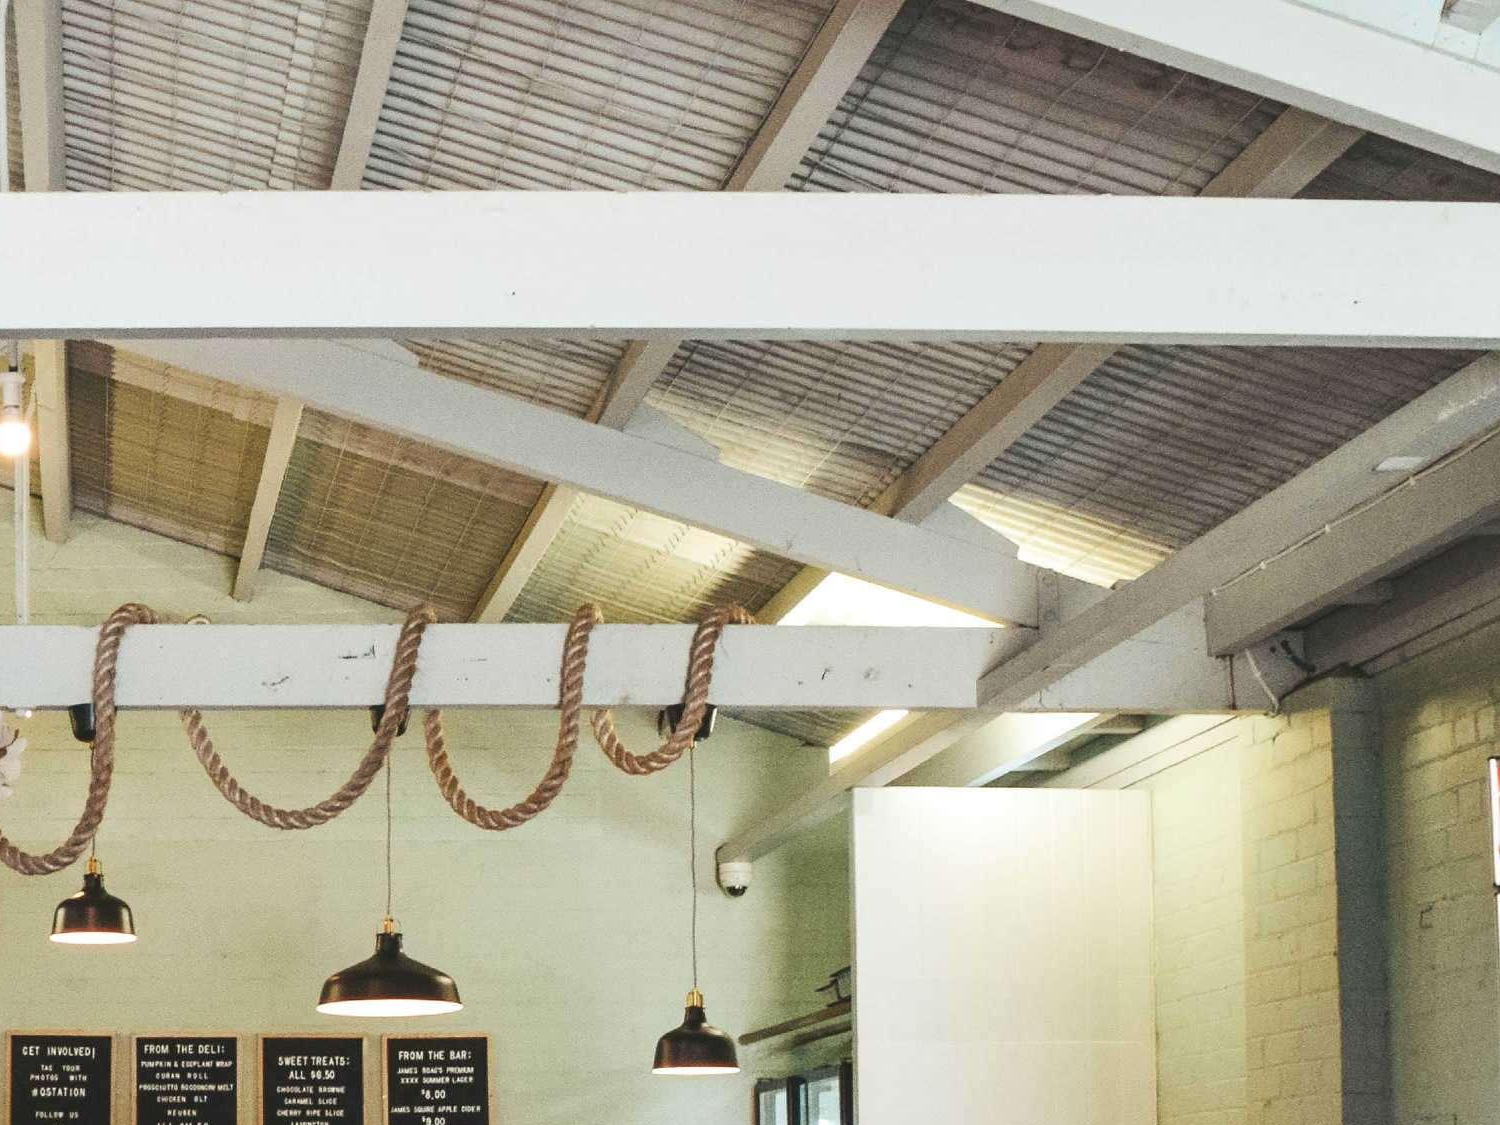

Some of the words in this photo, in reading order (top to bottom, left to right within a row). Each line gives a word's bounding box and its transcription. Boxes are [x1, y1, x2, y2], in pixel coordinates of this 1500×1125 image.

[22, 1046, 40, 1056] GET
[143, 1044, 169, 1054] FROM
[176, 1044, 194, 1054] THE
[198, 1044, 225, 1054] DELI:
[398, 1051, 424, 1060] FROM
[428, 1051, 445, 1060] THE
[450, 1050, 472, 1060] BAR:
[278, 1056, 308, 1066] SWEET
[311, 1056, 350, 1066] TREATS:
[41, 1064, 53, 1072] TAG
[62, 1064, 80, 1072] YOUR
[289, 1070, 305, 1080] ALL
[421, 1089, 446, 1100] $8.00
[35, 1111, 64, 1119] FOLLOW
[70, 1111, 79, 1119] US
[167, 1109, 197, 1117] REUBEN
[276, 1109, 302, 1117] CHERRY
[325, 1109, 344, 1117] SLICE
